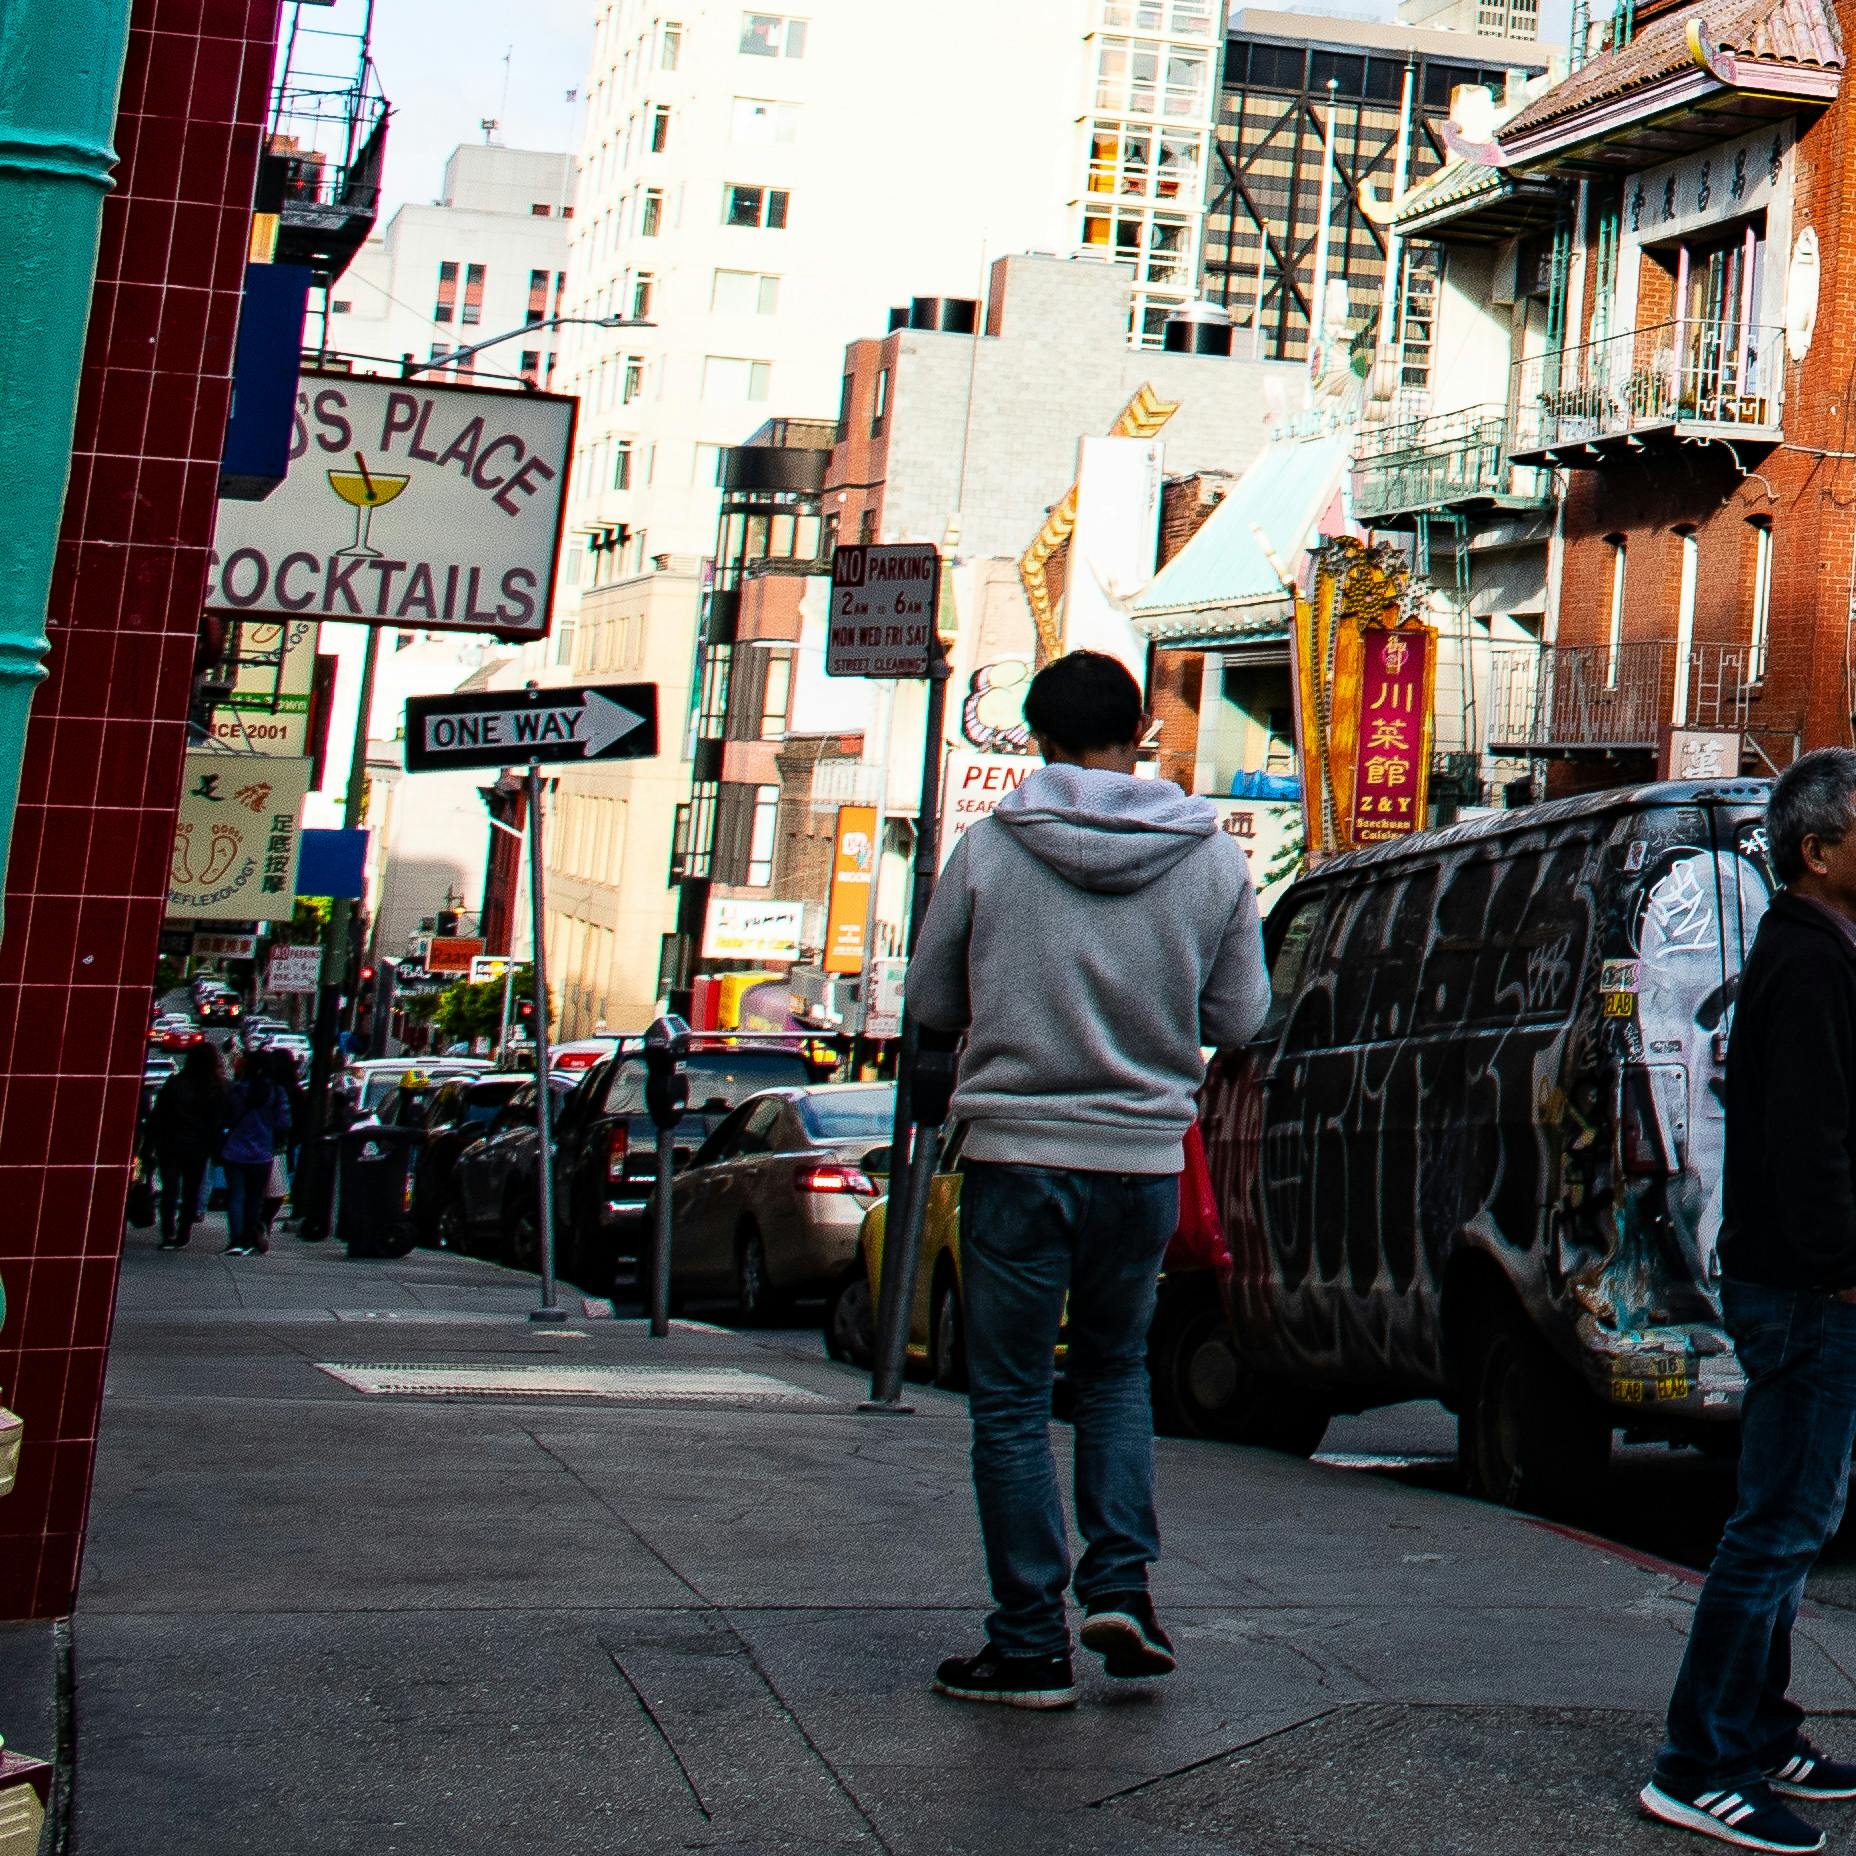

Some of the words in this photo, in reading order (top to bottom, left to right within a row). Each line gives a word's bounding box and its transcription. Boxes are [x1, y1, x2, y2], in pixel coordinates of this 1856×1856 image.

[380, 392, 556, 518] PLACE
[836, 551, 862, 582] NO
[868, 556, 931, 581] PARKING
[832, 626, 855, 647] MON
[859, 626, 881, 646] WED
[885, 625, 903, 646] FRI
[906, 624, 928, 645] SAT
[248, 724, 289, 741] 2001
[434, 717, 501, 745] ONE
[515, 711, 585, 740] WAY
[1364, 682, 1414, 787] 川菜館
[1360, 796, 1374, 812] Z
[1377, 796, 1392, 812] &
[1396, 796, 1411, 812] Y
